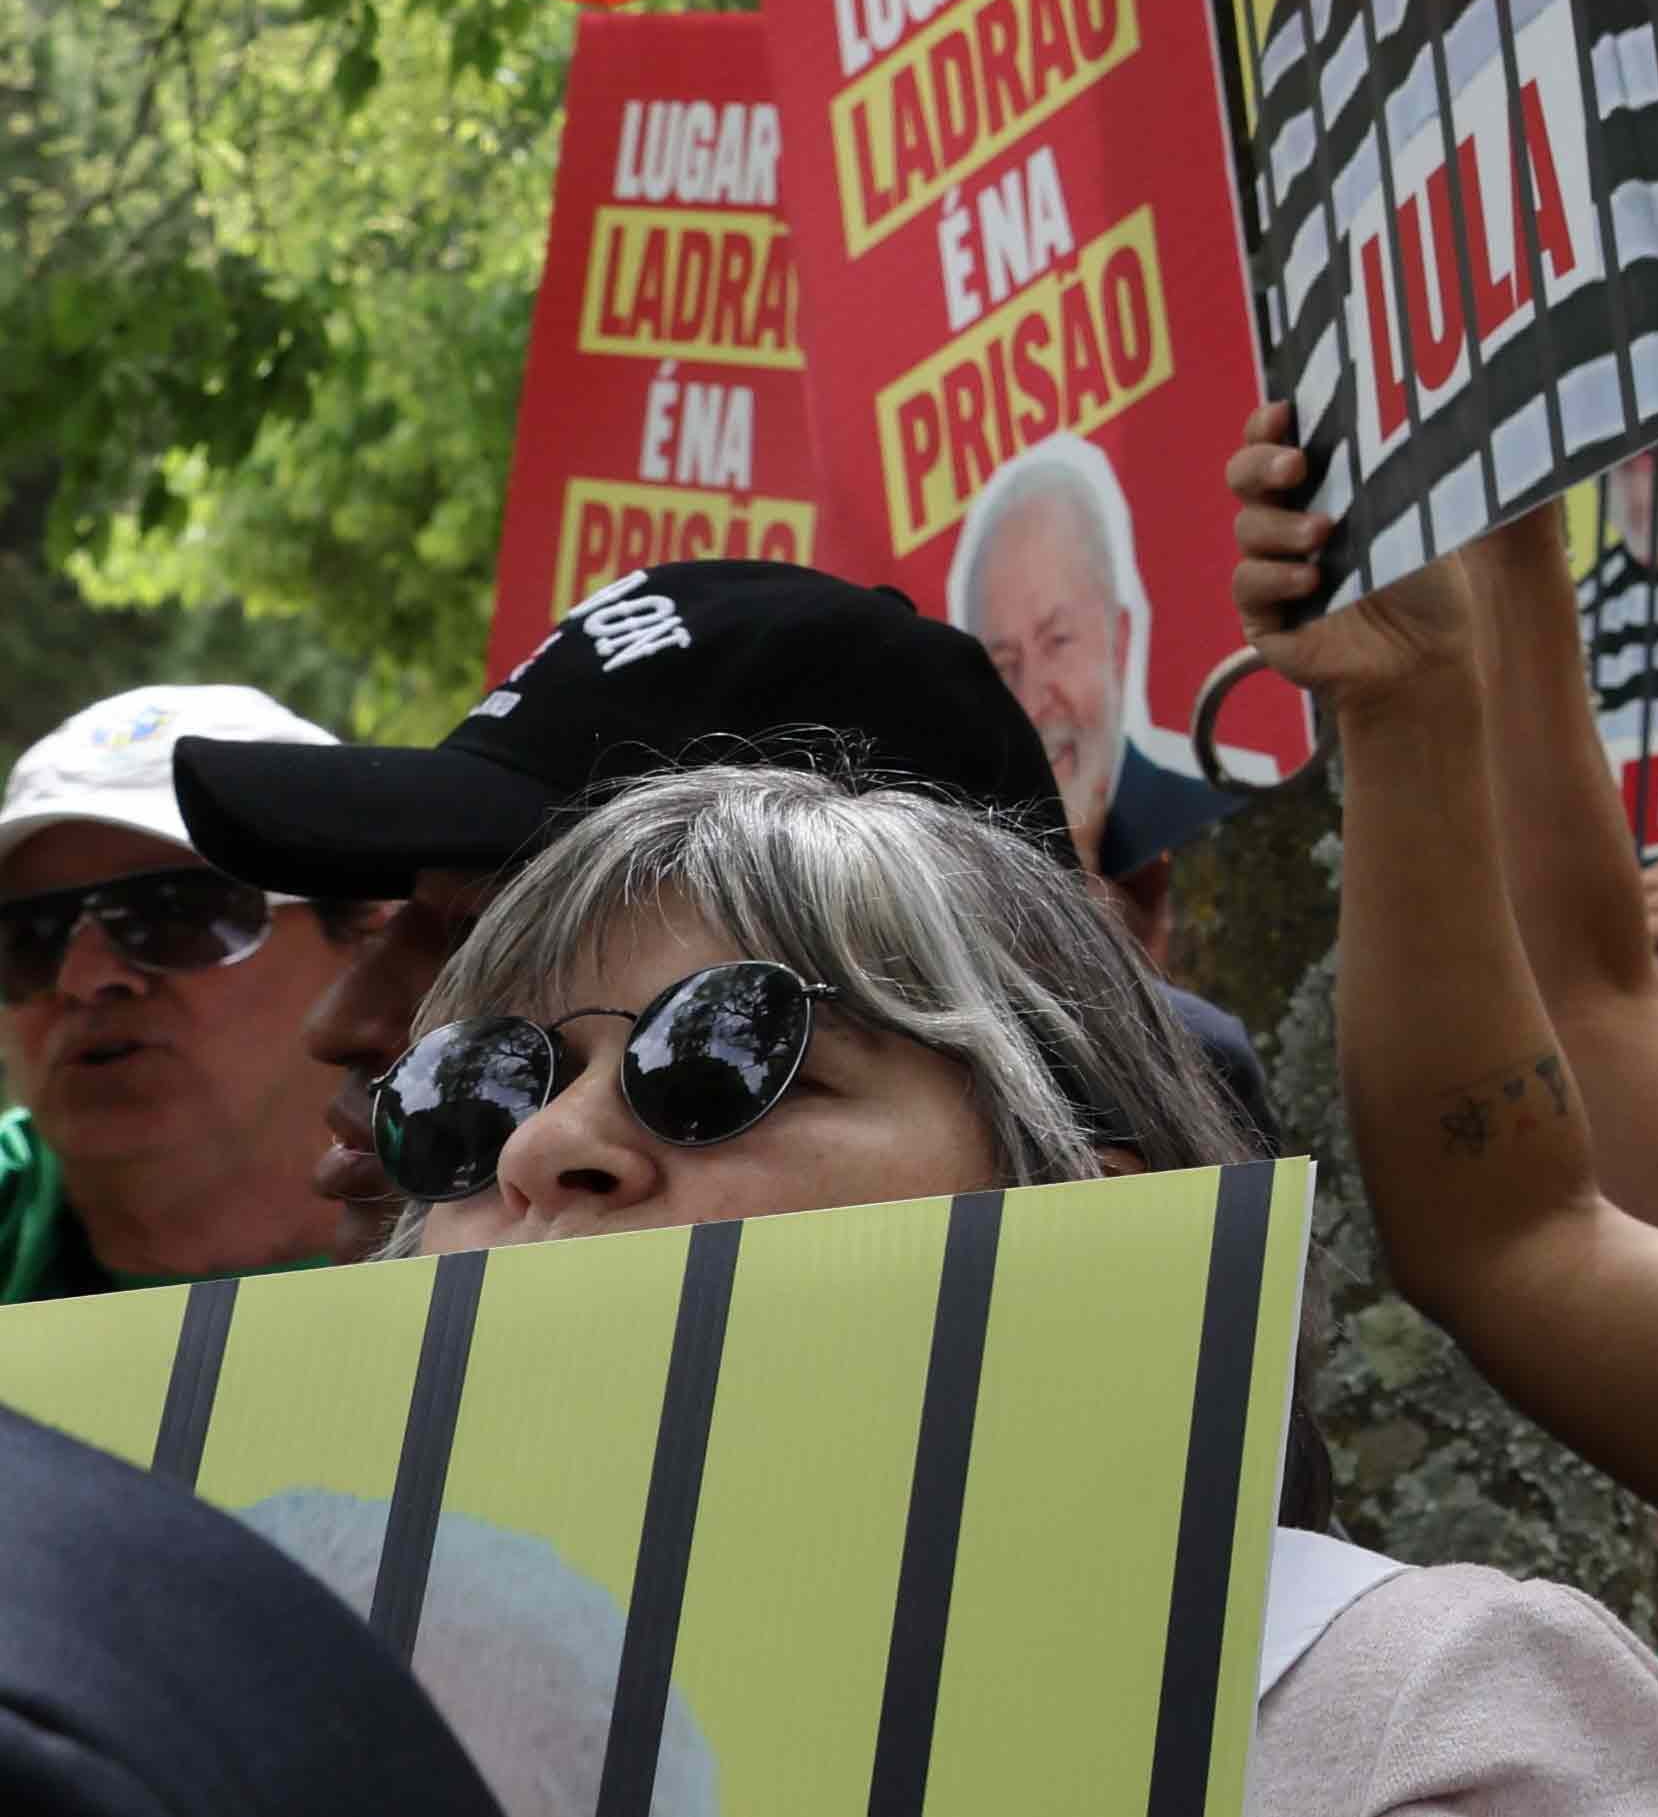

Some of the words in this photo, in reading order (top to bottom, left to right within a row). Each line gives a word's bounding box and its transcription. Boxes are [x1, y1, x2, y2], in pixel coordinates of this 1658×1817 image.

[613, 100, 781, 204] LUGAR
[597, 218, 799, 349] LADRÃ
[937, 186, 982, 332] É
[978, 146, 1073, 305] NA
[1361, 78, 1575, 443] LULA
[639, 358, 678, 481] É
[676, 381, 754, 488] NA
[896, 244, 1153, 529] PRISÃO
